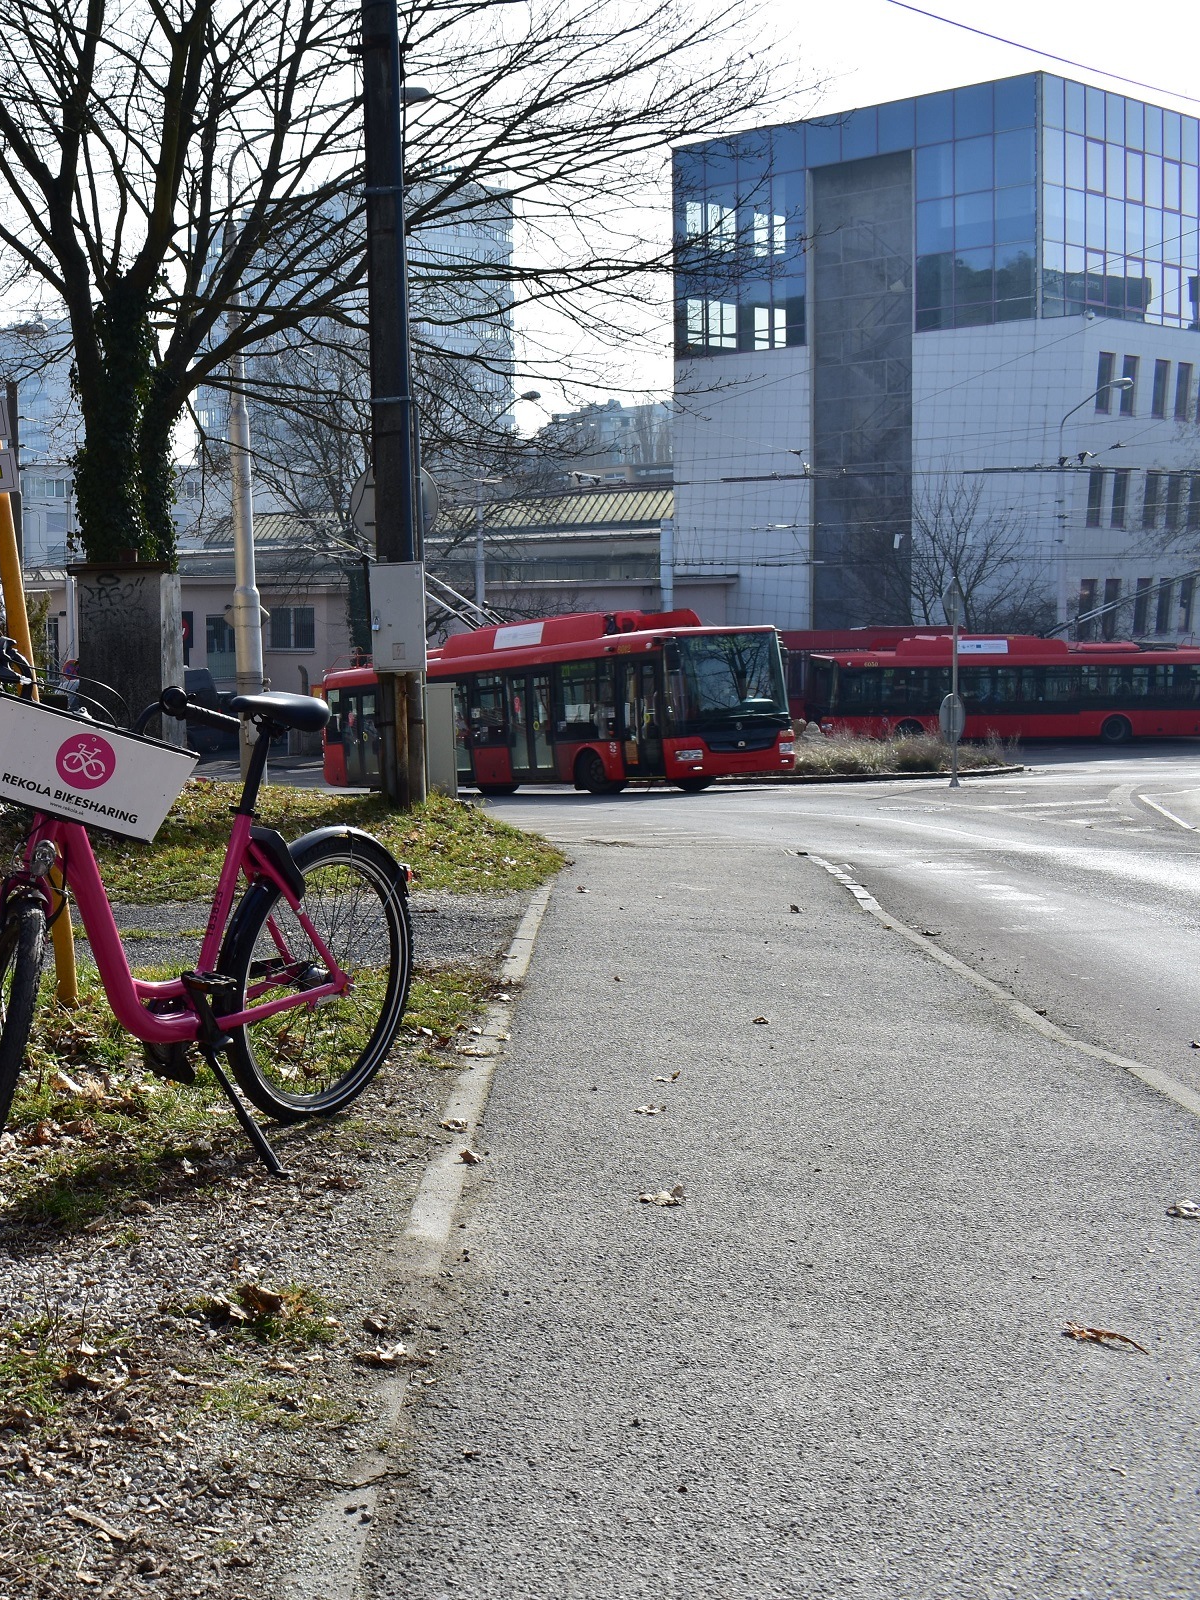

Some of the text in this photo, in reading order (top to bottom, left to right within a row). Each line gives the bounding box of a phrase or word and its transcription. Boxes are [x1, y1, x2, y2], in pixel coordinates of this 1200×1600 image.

[2, 772, 139, 825] REKOLA BIKESHARING
[49, 800, 84, 816] www.rekola.sk
